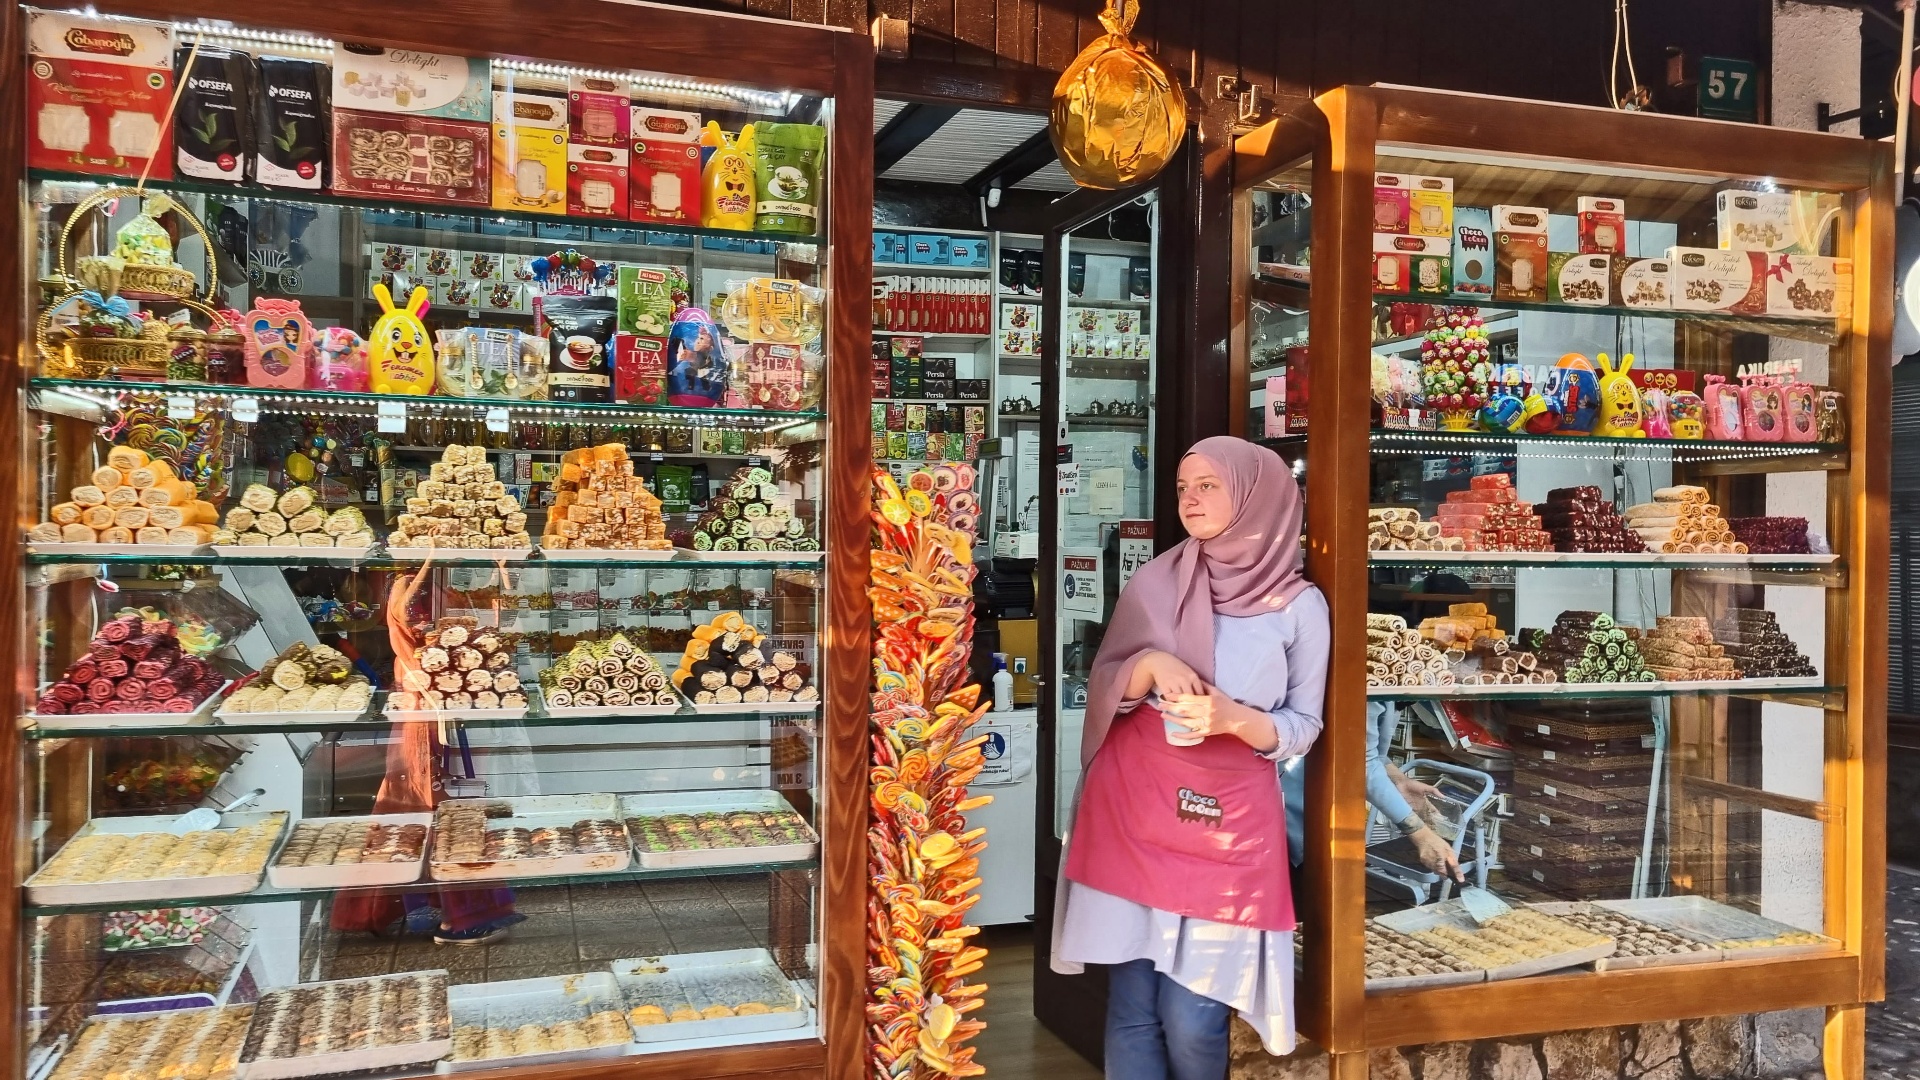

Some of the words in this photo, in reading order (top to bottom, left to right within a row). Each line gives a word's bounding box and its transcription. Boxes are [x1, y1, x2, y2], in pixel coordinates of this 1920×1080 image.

[390, 50, 439, 69] Delight
[198, 79, 233, 92] OFSEFA
[1708, 69, 1747, 99] 57
[279, 88, 312, 100] OFSEFA
[1460, 227, 1482, 235] Choco
[631, 281, 665, 296] TEA
[764, 292, 793, 304] TEA
[478, 341, 510, 356] TEA
[628, 350, 662, 364] TEA
[765, 358, 794, 370] TEA
[1127, 525, 1148, 535] PAŽNJA!
[1178, 788, 1216, 806] Choco
